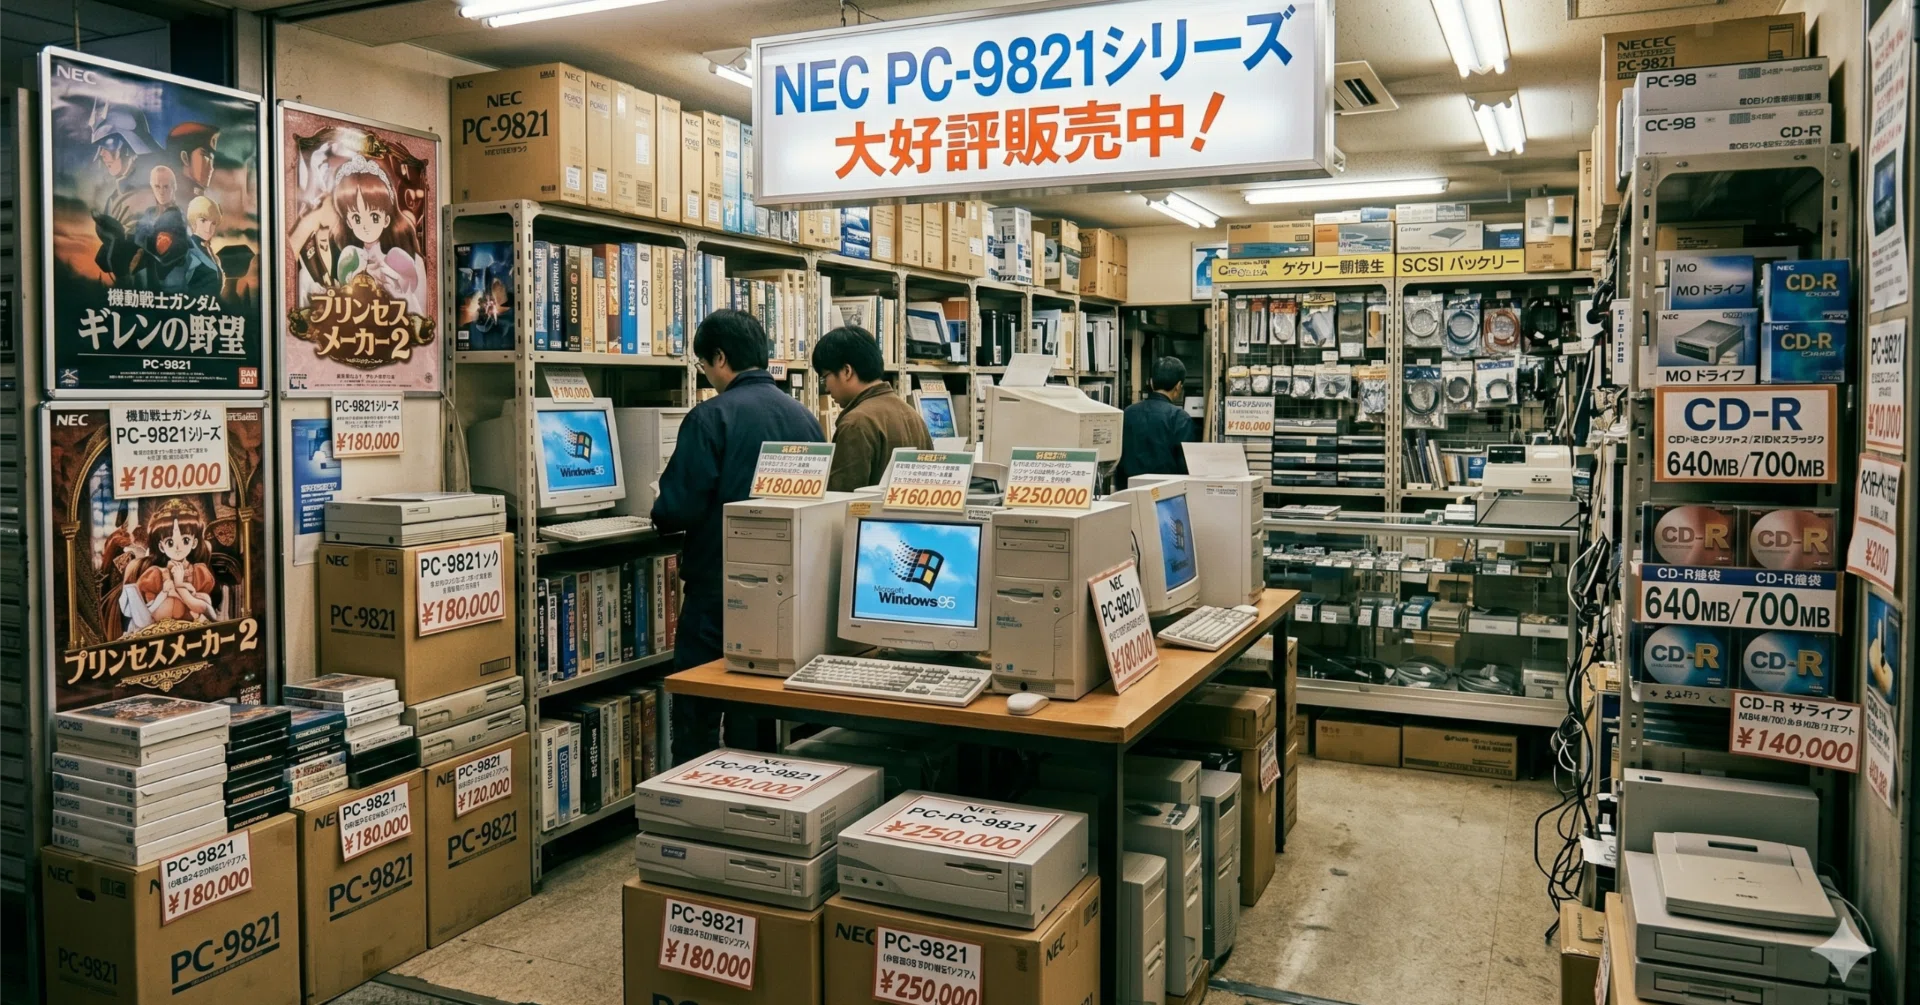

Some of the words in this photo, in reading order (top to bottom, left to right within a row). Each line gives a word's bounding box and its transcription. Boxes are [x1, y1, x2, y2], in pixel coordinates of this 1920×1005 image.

[775, 55, 870, 115] NEC
[886, 4, 1296, 105] PC-9821シリーズ
[1617, 56, 1675, 72] PC-9821
[57, 65, 97, 85] NEC
[456, 81, 473, 89] NEC
[565, 71, 582, 82] NEC
[590, 80, 607, 91] NEC
[1646, 73, 1697, 88] PC-98
[486, 91, 522, 108] NEC
[462, 109, 549, 145] PC-9821
[685, 118, 699, 127] NEC
[707, 118, 722, 127] NEC
[1645, 117, 1696, 132] CC-98
[1780, 125, 1822, 138] CD-R
[1402, 256, 1444, 273] SCSI
[1450, 254, 1520, 271] バッケリー
[1676, 263, 1697, 272] MO
[1676, 285, 1700, 296] MO
[1786, 273, 1837, 290] CD-R
[108, 288, 221, 311] 機動戦士ガンダム
[310, 289, 410, 326] プリンセス
[78, 307, 246, 355] ギレンの野望
[1781, 332, 1832, 350] CD-R
[317, 326, 411, 360] メーカー2
[1871, 334, 1902, 365] PC-9821
[142, 359, 191, 370] PC-9821
[1666, 370, 1691, 382] MO
[126, 409, 212, 422] 機動戦士ガンダム
[335, 399, 399, 412] PC-9821シリーズ
[1684, 397, 1803, 431] CD-R
[56, 414, 88, 426] NEC
[116, 425, 222, 444] PC-9821シリーズ
[336, 432, 400, 451] ¥180,000
[1666, 450, 1825, 478] 640MB/700MB
[120, 461, 222, 491] ¥180,000
[755, 476, 822, 495] ¥180,000
[887, 487, 962, 506] ¥160,000
[1007, 486, 1088, 506] ¥250,000
[1662, 523, 1730, 549] CD-R
[1757, 527, 1829, 553] CD-R
[326, 555, 349, 567] NEC
[1109, 574, 1125, 592] NEC
[421, 590, 500, 627] ¥180,000
[879, 592, 938, 608] Windows
[937, 595, 956, 610] 95
[1645, 586, 1830, 629] 640MB/700MB
[331, 604, 396, 632] PC-9821
[1112, 629, 1153, 679] ¥180,000
[1651, 643, 1720, 669] CD-R
[1751, 649, 1824, 677] CD-R
[1740, 696, 1785, 713] CD-R
[1737, 727, 1854, 763] ¥140,000
[459, 755, 500, 780] PC-9821
[705, 760, 822, 782] PC-PC-9821
[758, 758, 793, 767] NEC
[436, 770, 455, 788] NE
[458, 777, 510, 810] ¥120,000
[343, 789, 396, 820] PC-9821
[964, 805, 1007, 815] NEC
[314, 810, 340, 831] NE
[907, 807, 1037, 833] PC-PC-9821
[447, 810, 517, 861] PC-9821
[167, 840, 234, 878] PC-9821
[47, 866, 74, 885] NEC
[329, 853, 413, 913] PC-9821
[168, 867, 250, 915] ¥180,000
[671, 903, 744, 935] PC-9821
[171, 911, 280, 985] PC-9821
[884, 932, 968, 964] PC-9821
[1045, 932, 1067, 966] NEC
[58, 946, 118, 985] PC-9821
[665, 938, 751, 980] ¥180,000
[880, 968, 978, 1005] ¥250,000
